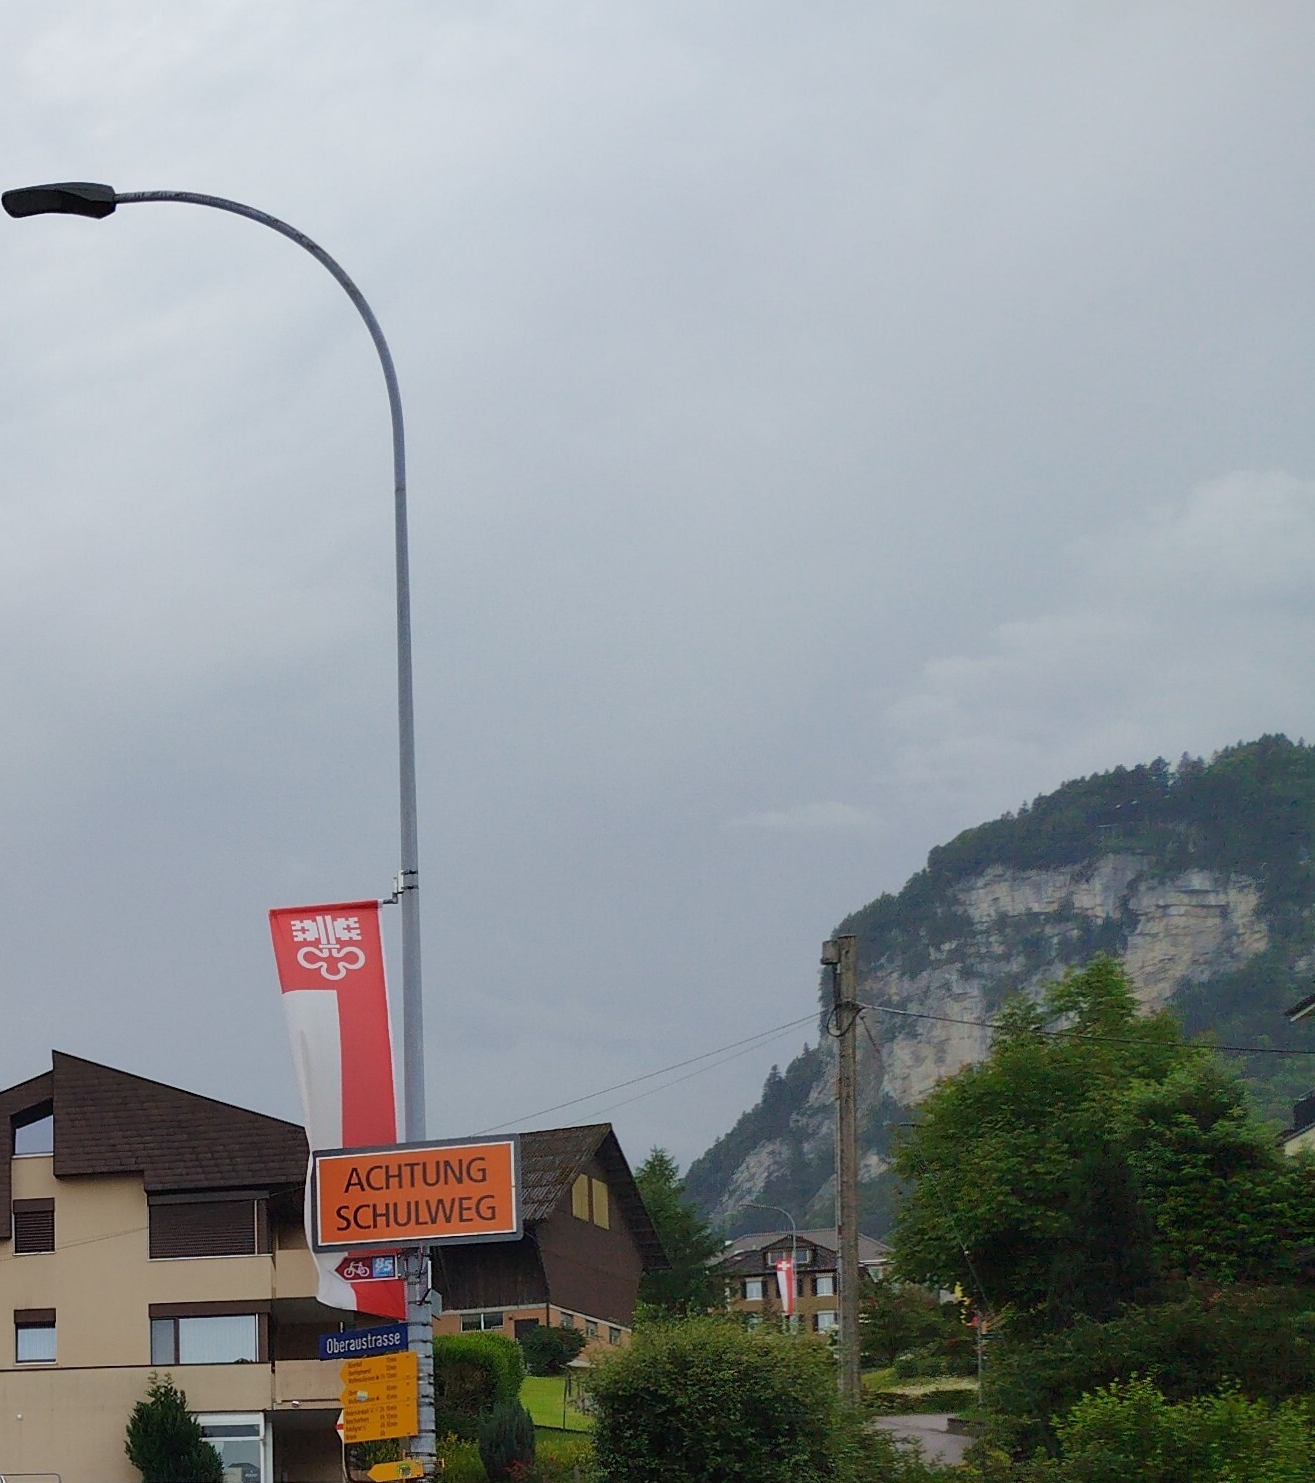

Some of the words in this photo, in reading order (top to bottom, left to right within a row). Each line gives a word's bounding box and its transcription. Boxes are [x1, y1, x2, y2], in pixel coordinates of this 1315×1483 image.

[344, 1157, 487, 1194] ACHTUNG
[336, 1194, 497, 1232] SCHULWEG
[375, 1257, 393, 1272] 85
[326, 1331, 401, 1355] Oberaustrasse
